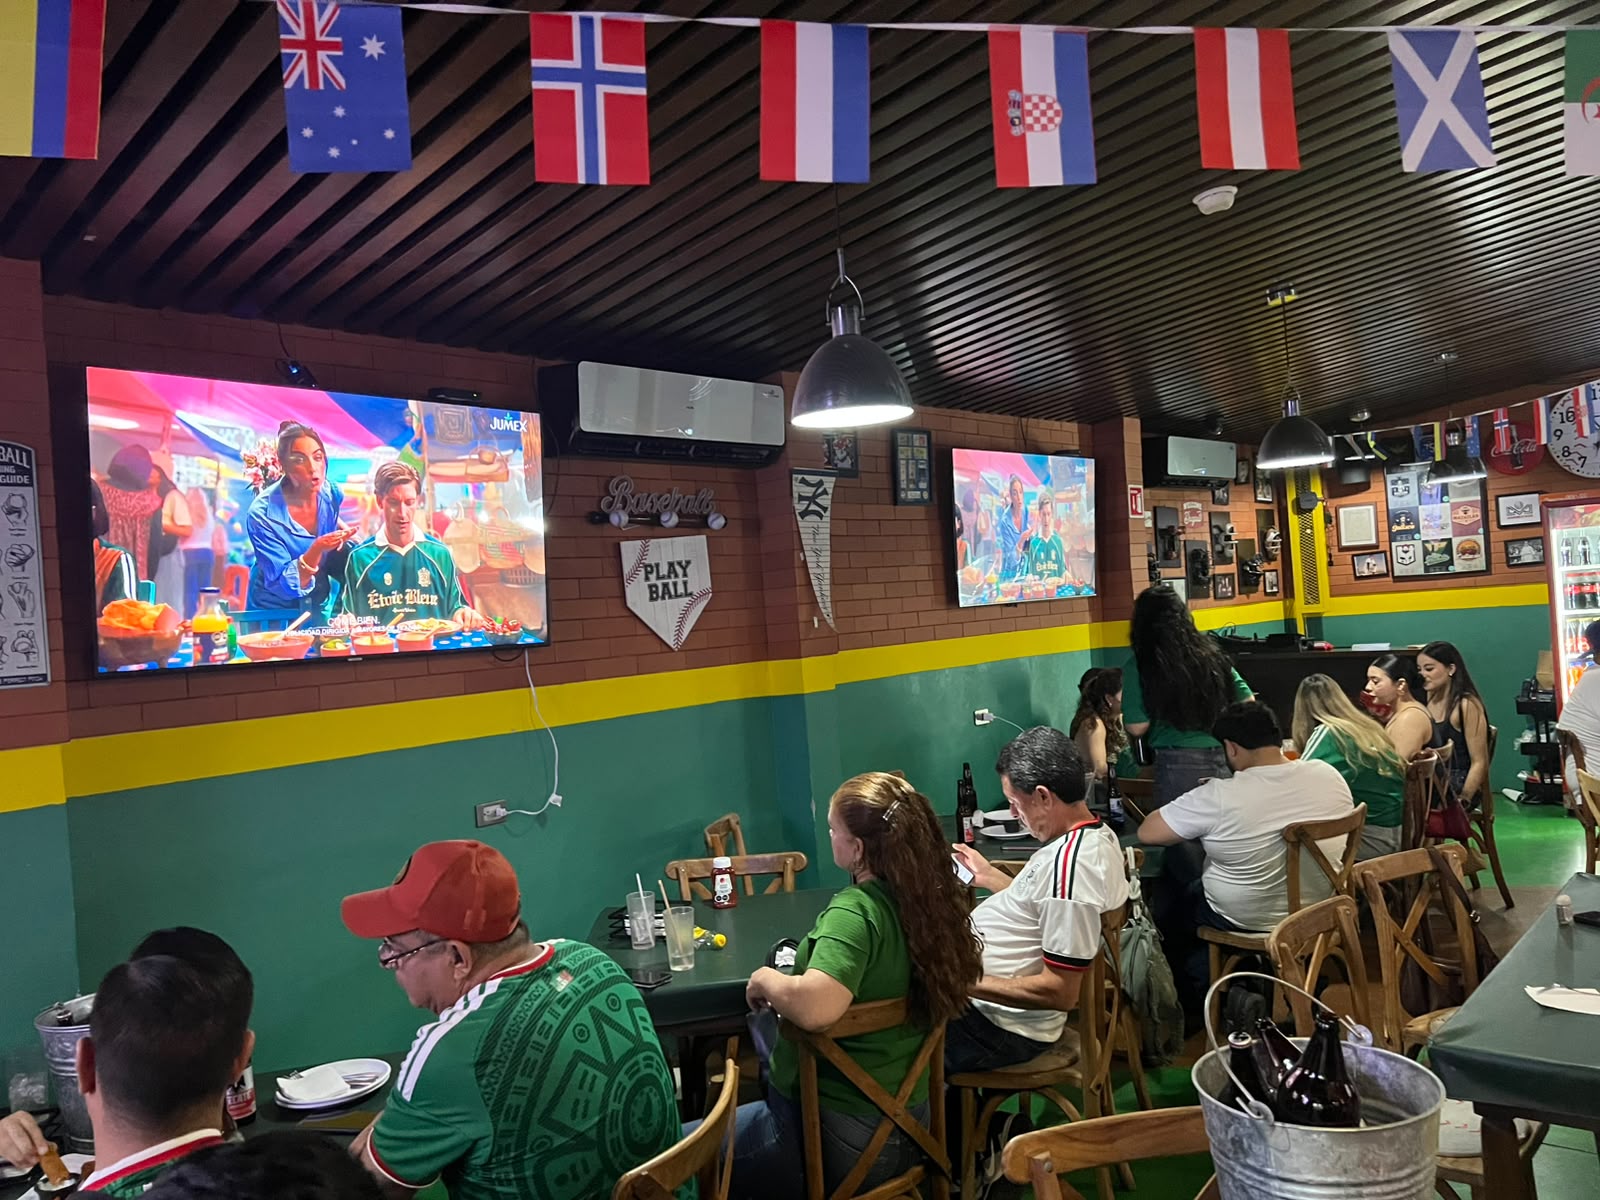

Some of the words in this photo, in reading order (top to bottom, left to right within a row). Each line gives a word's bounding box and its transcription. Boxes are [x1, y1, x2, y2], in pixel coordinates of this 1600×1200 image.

[490, 416, 528, 432] JUMEX
[1553, 428, 1564, 441] 9
[1561, 445, 1571, 458] 8
[1578, 455, 1588, 468] 7
[0, 474, 30, 484] GUIDE
[601, 475, 716, 514] Baseball
[643, 560, 692, 582] PLAY
[648, 579, 694, 602] BALL
